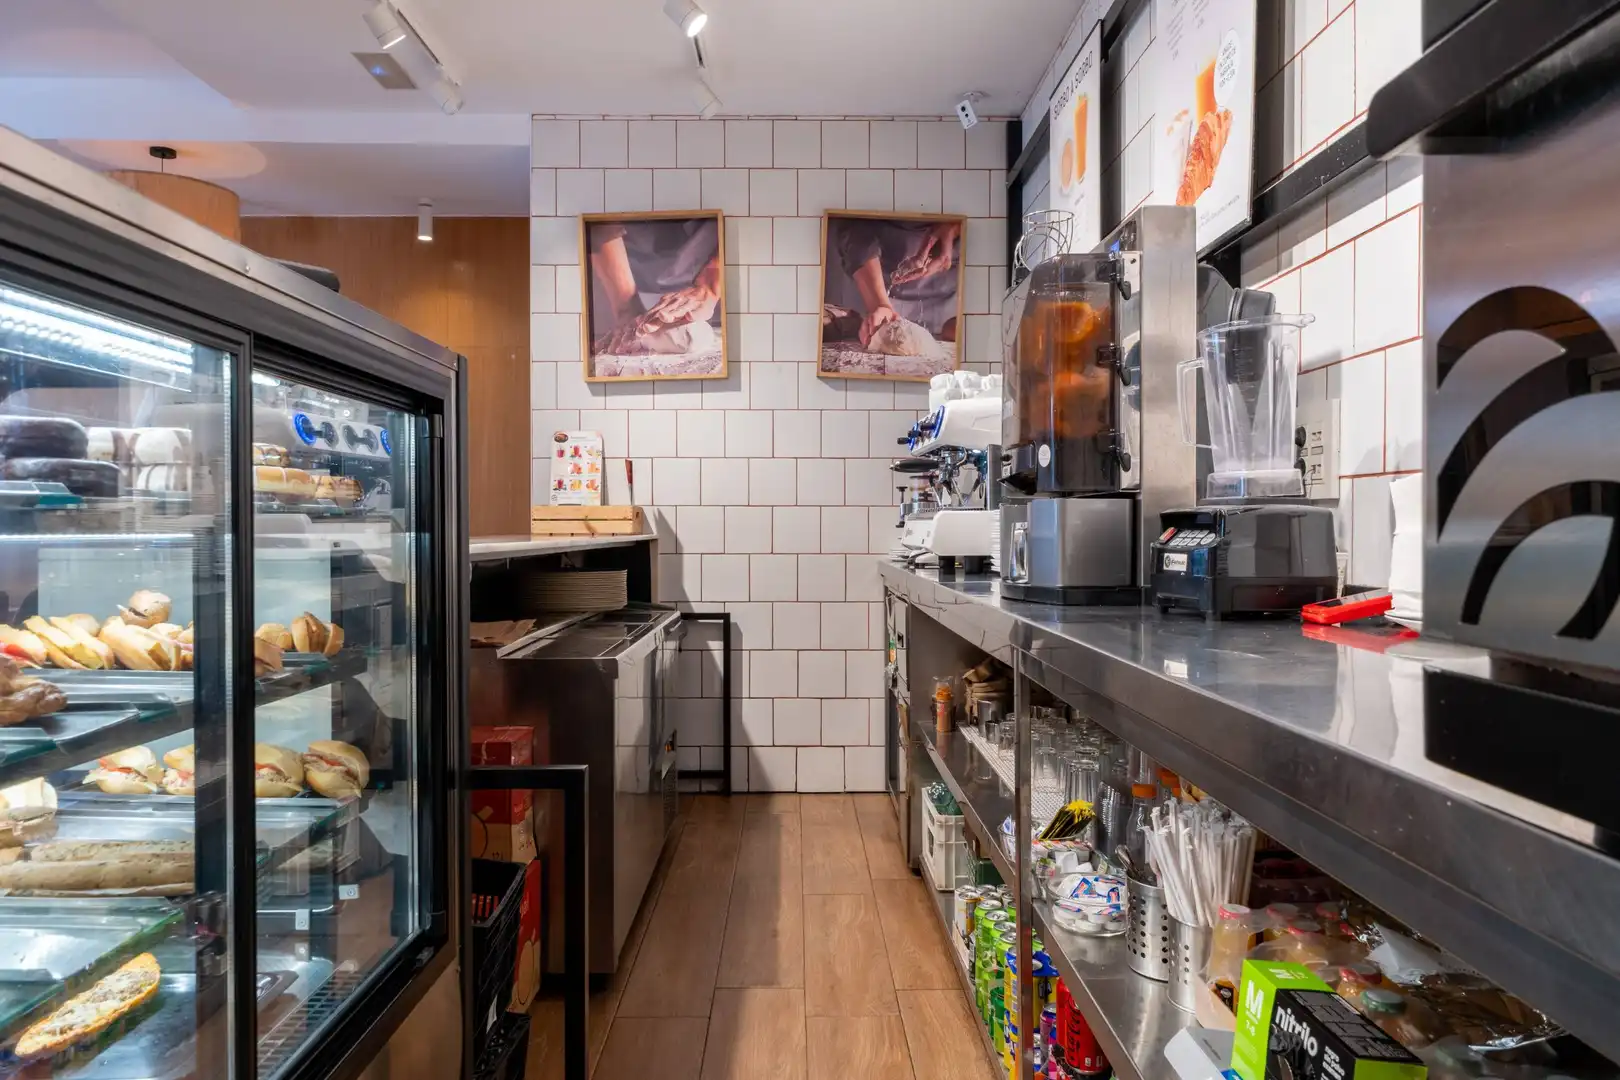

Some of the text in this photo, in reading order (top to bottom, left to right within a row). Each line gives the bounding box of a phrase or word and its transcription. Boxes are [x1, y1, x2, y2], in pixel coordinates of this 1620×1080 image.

[1054, 85, 1069, 120] SORBO
[1075, 50, 1092, 89] SORBO
[1245, 979, 1265, 1020] M
[1275, 1006, 1319, 1057] nitrilo
